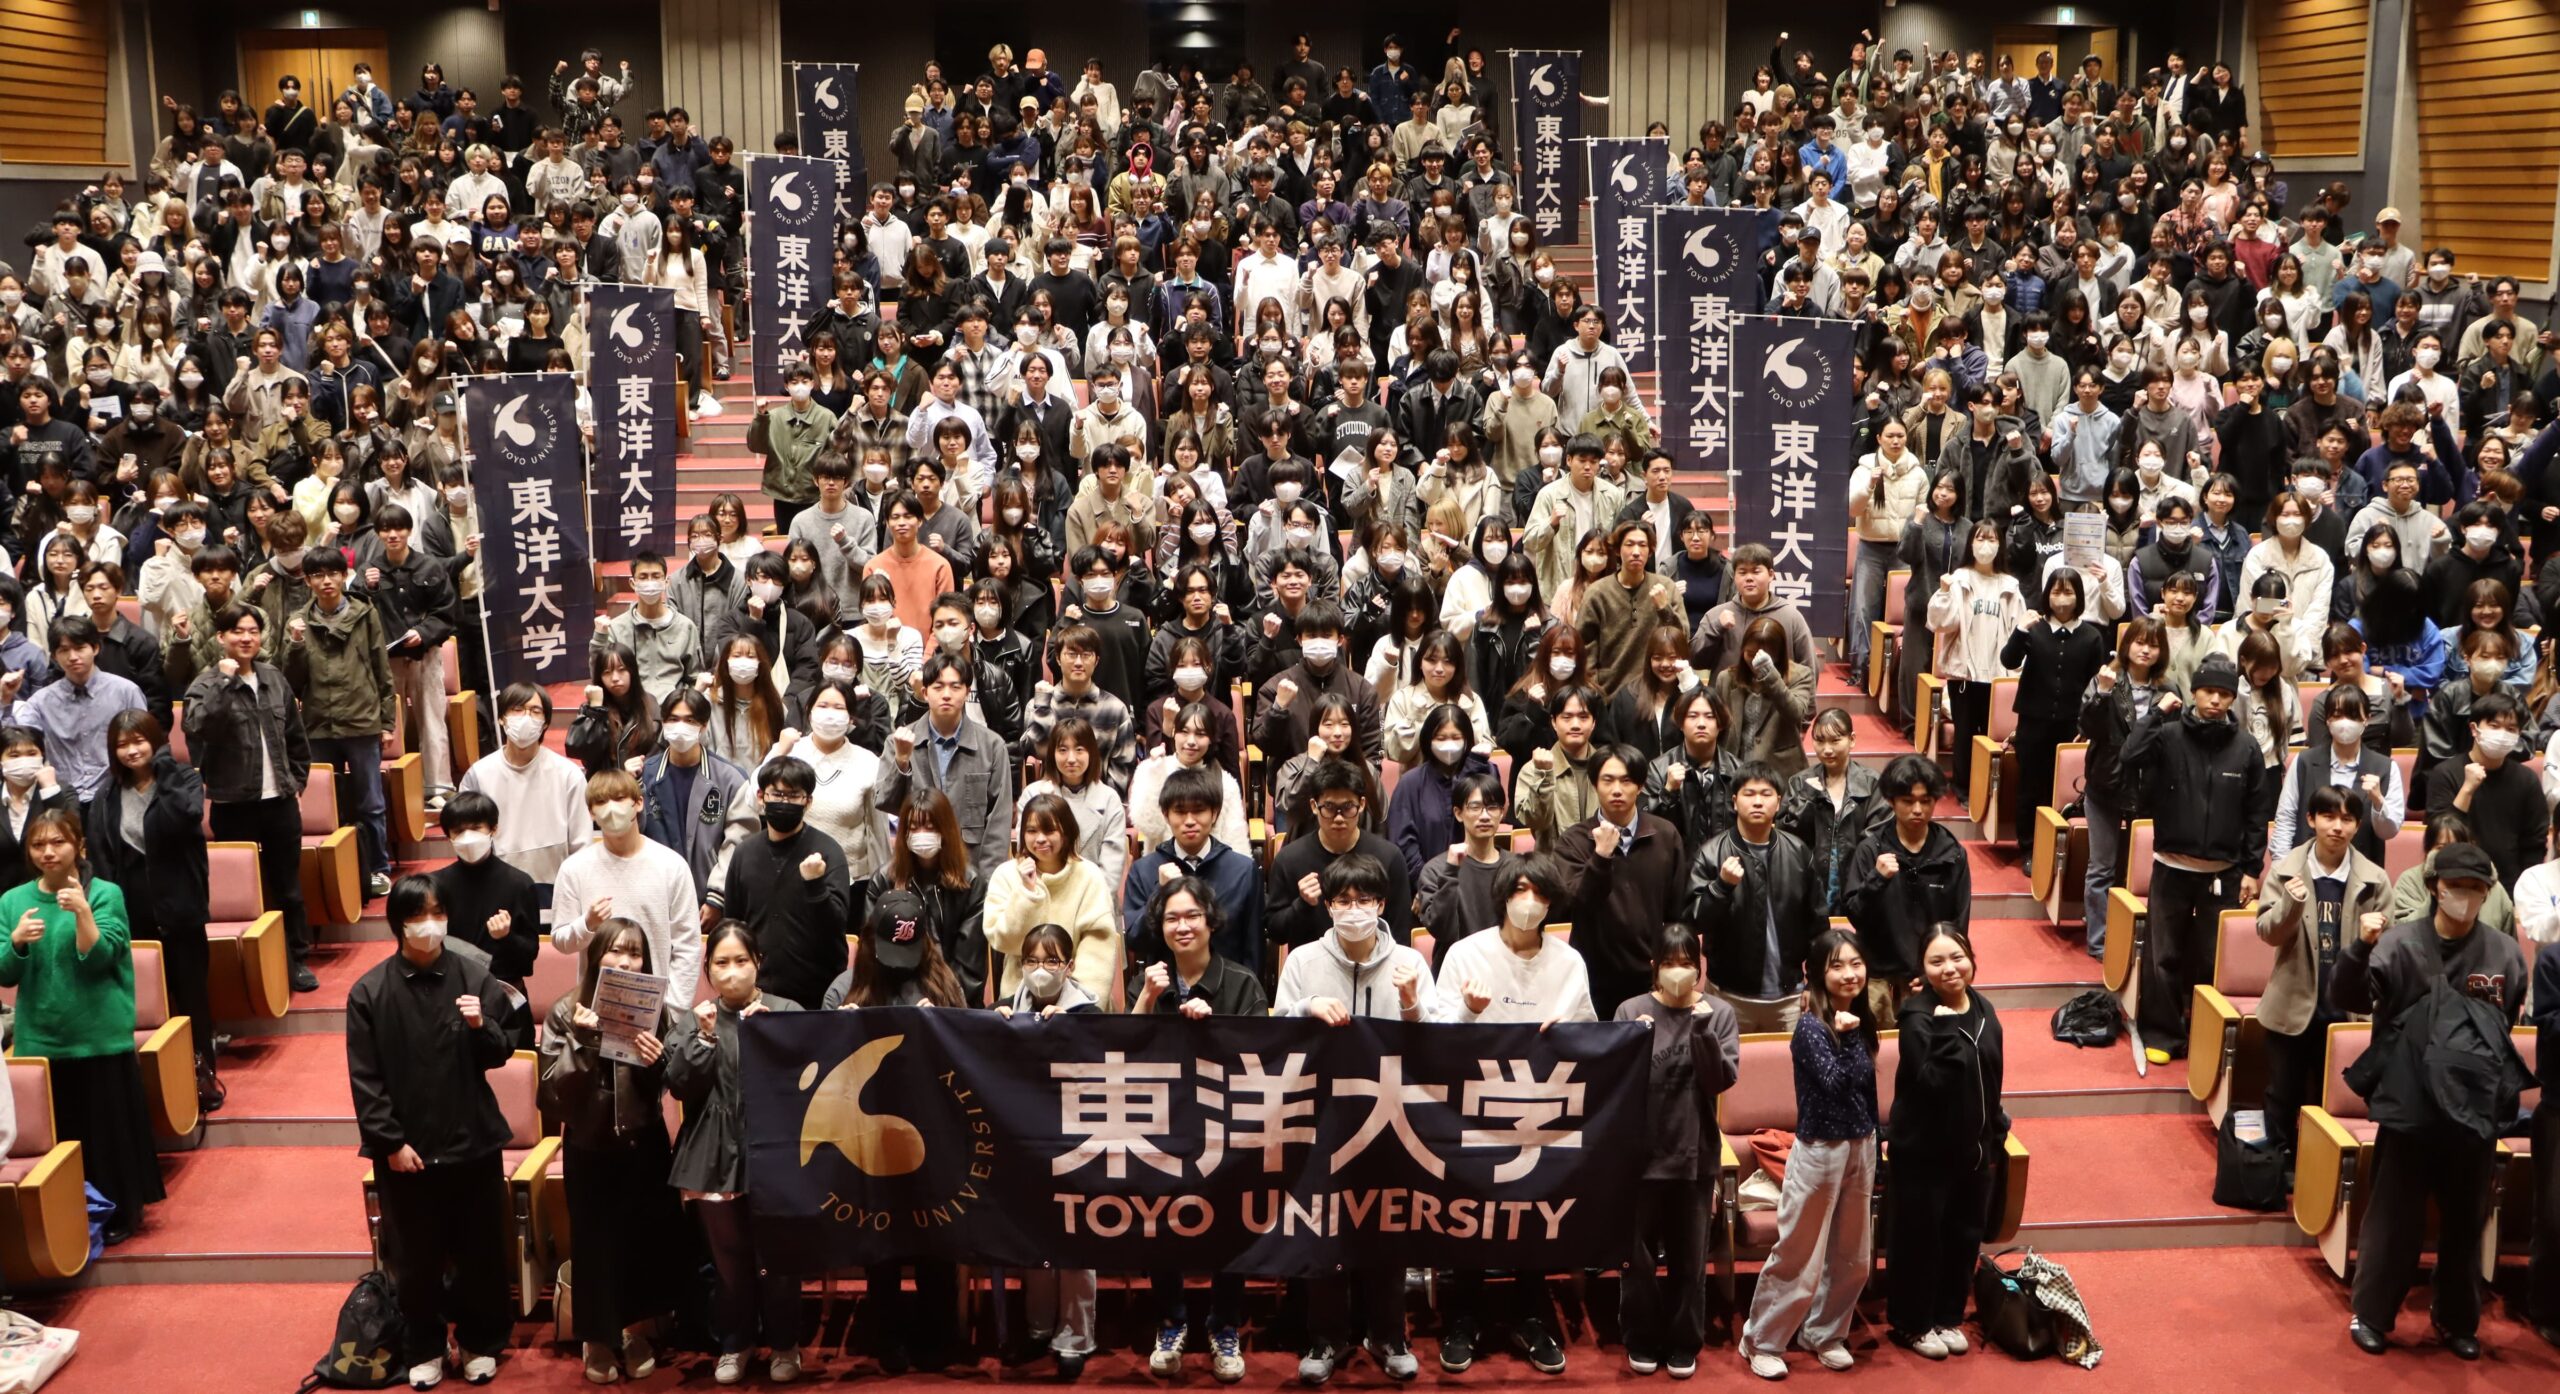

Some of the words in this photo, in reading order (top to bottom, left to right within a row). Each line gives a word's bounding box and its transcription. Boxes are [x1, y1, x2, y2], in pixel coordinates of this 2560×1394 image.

[773, 208, 792, 225] TOYO
[796, 180, 819, 226] UNIVERSITY
[822, 128, 852, 244] 東洋大
[1535, 114, 1563, 237] 東洋大学
[1631, 161, 1655, 206] UNIVERSITY
[1616, 214, 1648, 363] 東洋大学
[1686, 265, 1708, 284] TOYO
[1712, 233, 1740, 284] UNIVERSITY
[636, 312, 661, 364] UNIVERSITY
[1689, 293, 1730, 458] 東洋大学
[1767, 386, 1793, 409] TOYO
[1800, 349, 1832, 409] UNIVERSITY
[501, 446, 526, 466] TOYO
[531, 402, 558, 466] UNIVERSITY
[617, 374, 653, 548] 東洋大学
[1336, 421, 1372, 440] STUDIUM
[508, 477, 567, 671] 東洋大学
[1651, 1043, 1690, 1070] PROPERT
[1050, 1051, 1586, 1184] 東洋大学
[820, 1191, 891, 1231] TOYO
[913, 1069, 995, 1228] UNIVERSITY
[1052, 1192, 1215, 1239] TOYO
[1241, 1187, 1577, 1240] UNIVERSITY
